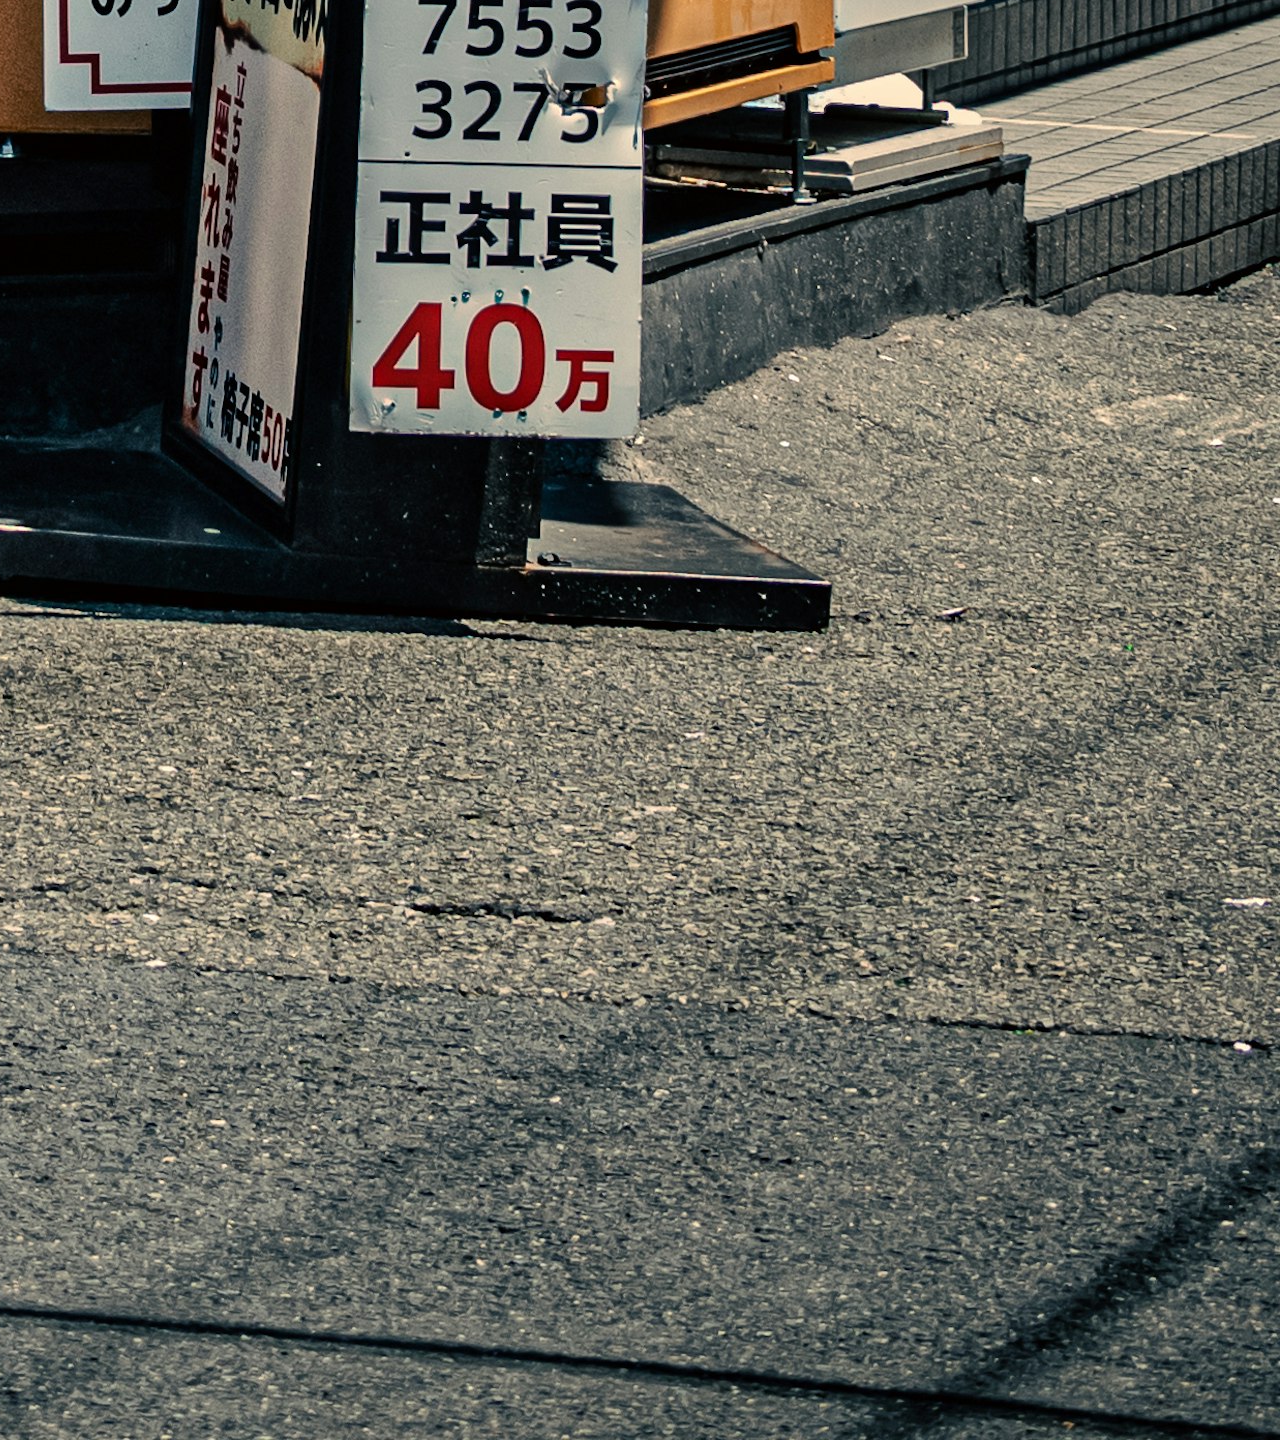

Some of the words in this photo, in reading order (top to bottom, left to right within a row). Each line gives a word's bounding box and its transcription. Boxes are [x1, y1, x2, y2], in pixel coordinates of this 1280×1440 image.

[410, 79, 604, 143] 3275
[191, 82, 232, 421] 座れます
[375, 186, 621, 273] 正社員
